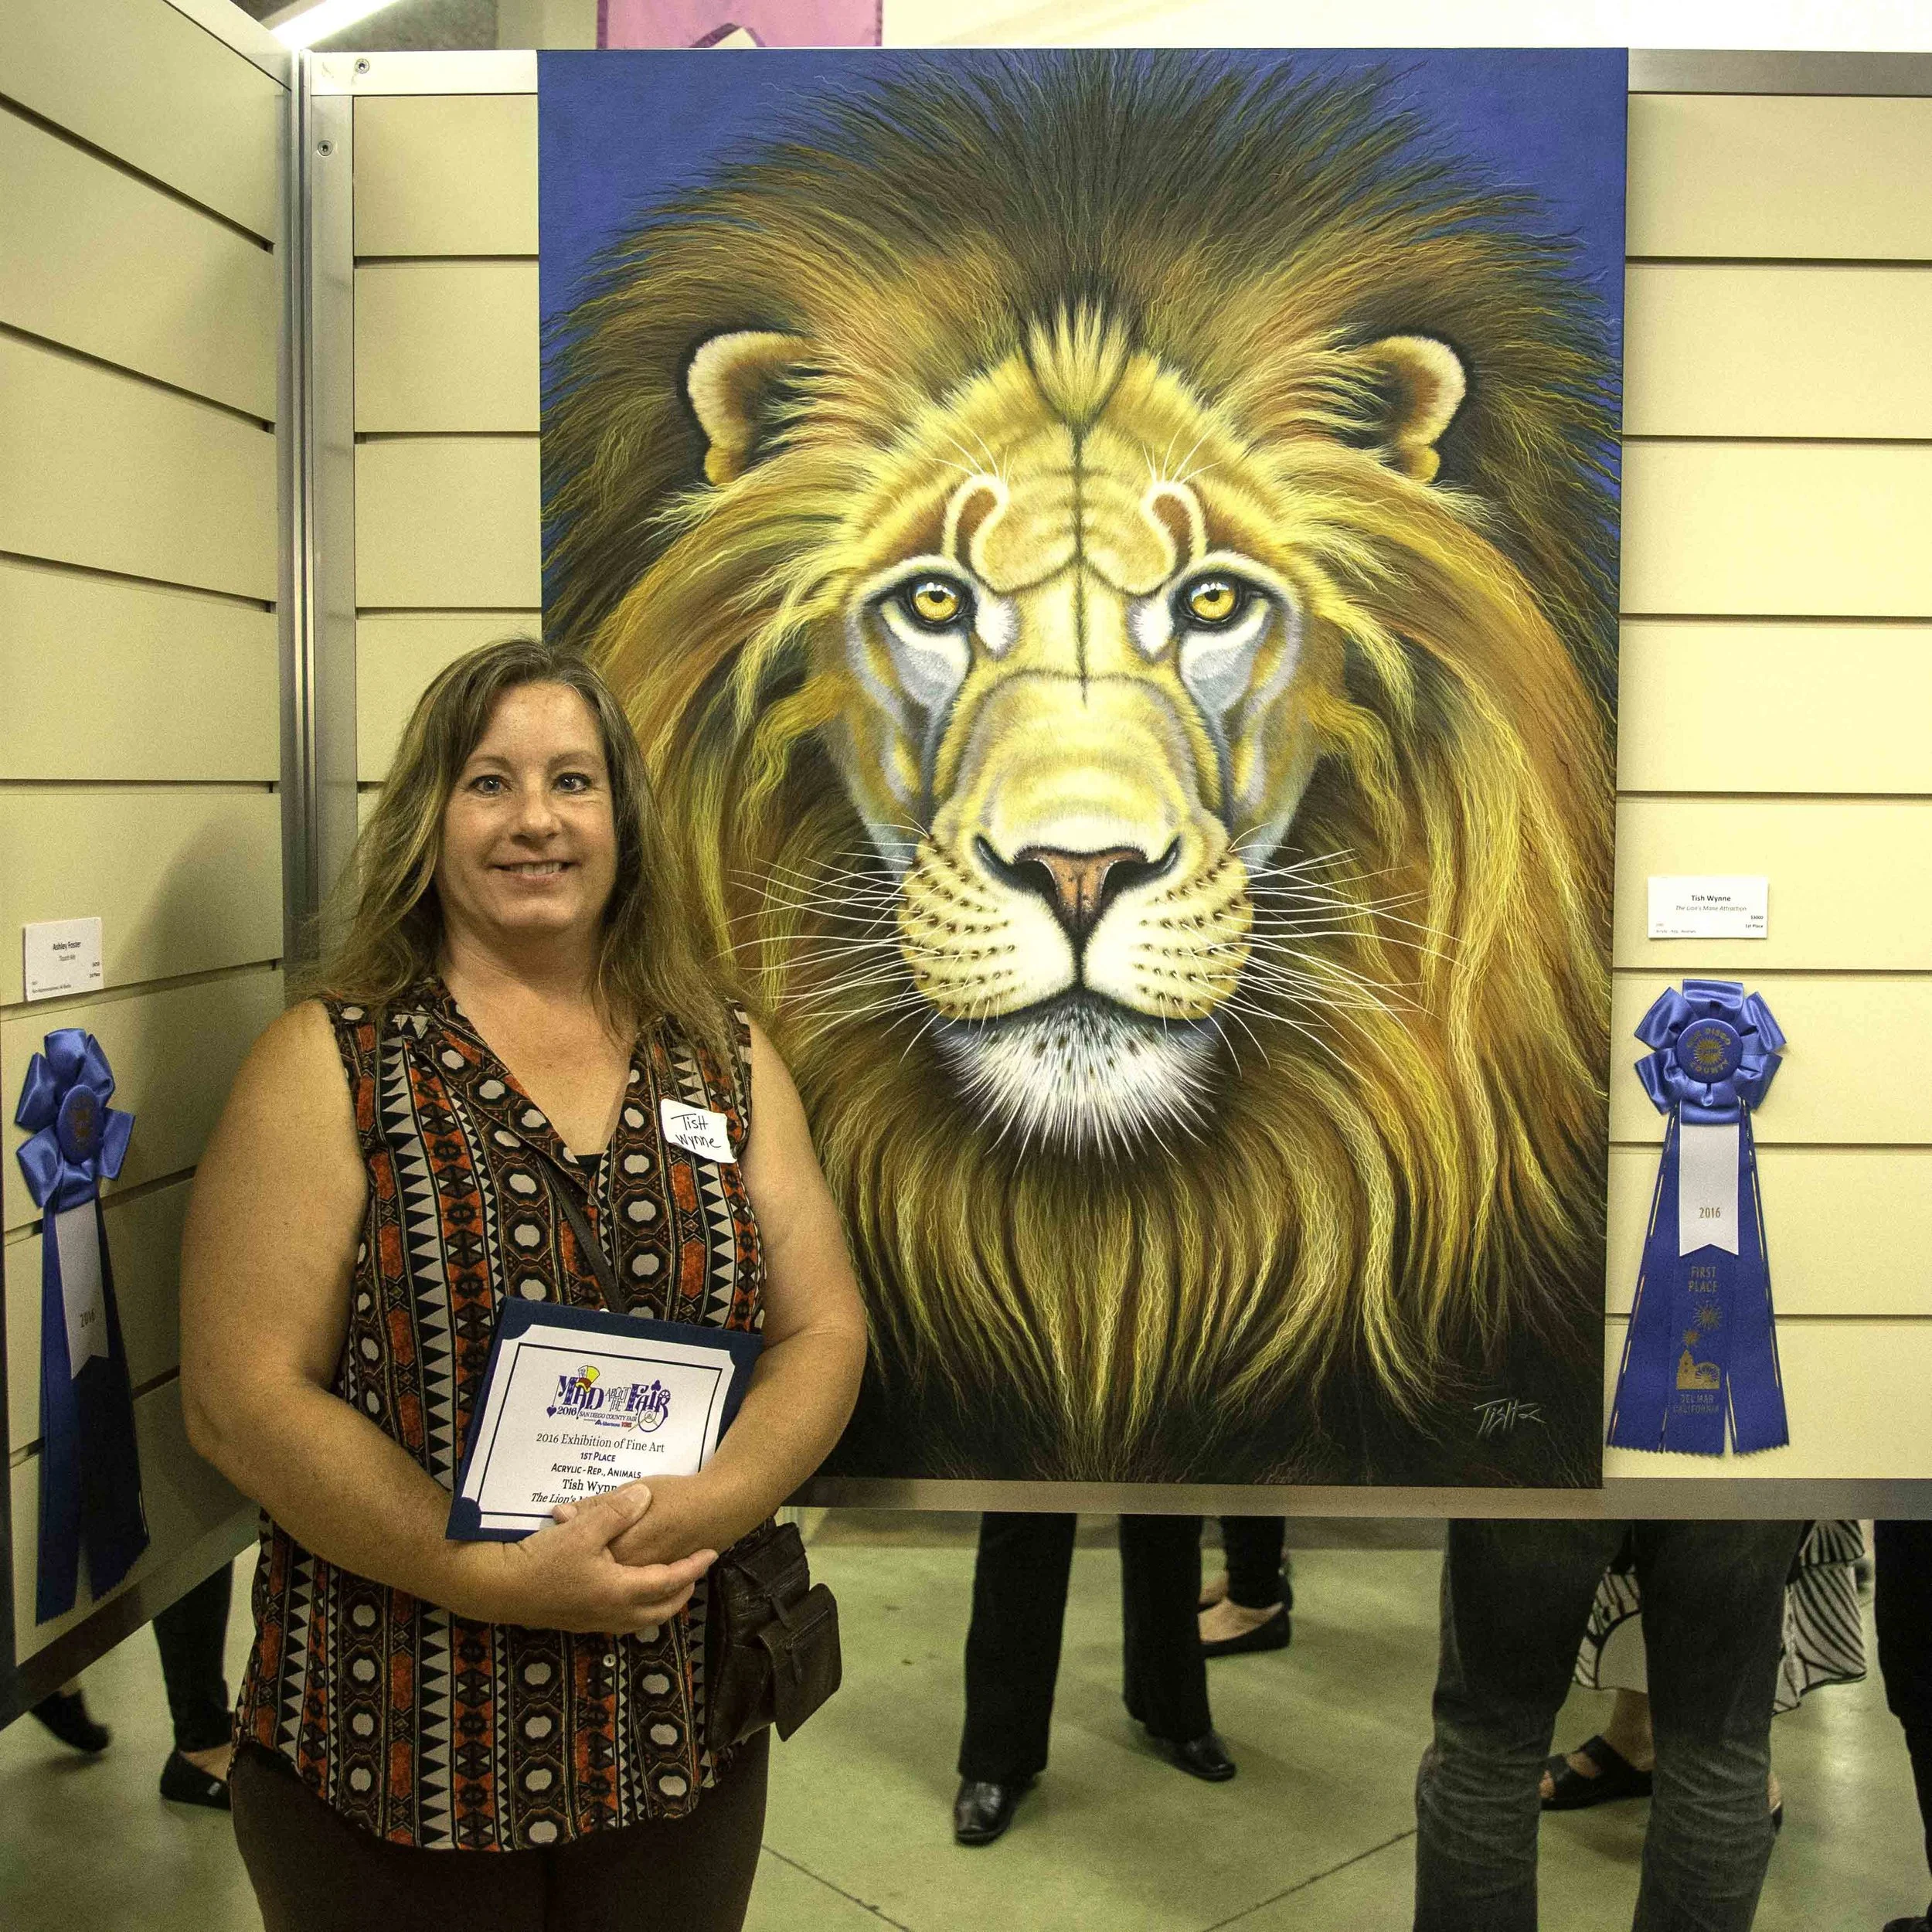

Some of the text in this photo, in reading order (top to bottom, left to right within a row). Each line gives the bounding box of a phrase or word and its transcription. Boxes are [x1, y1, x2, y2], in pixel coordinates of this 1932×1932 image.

[675, 1134, 722, 1150] Wynne
[1699, 1207, 1721, 1219] 2016
[1691, 1267, 1717, 1278] FIRST
[1688, 1280, 1719, 1292] PLACE
[556, 1406, 577, 1416] 2016
[536, 1433, 665, 1453] 2016 Exhibition of Fine Art
[580, 1452, 593, 1461] 1ST
[563, 1478, 617, 1495] Tish Wynn
[530, 1492, 548, 1502] The
[549, 1493, 577, 1504] Lion's
